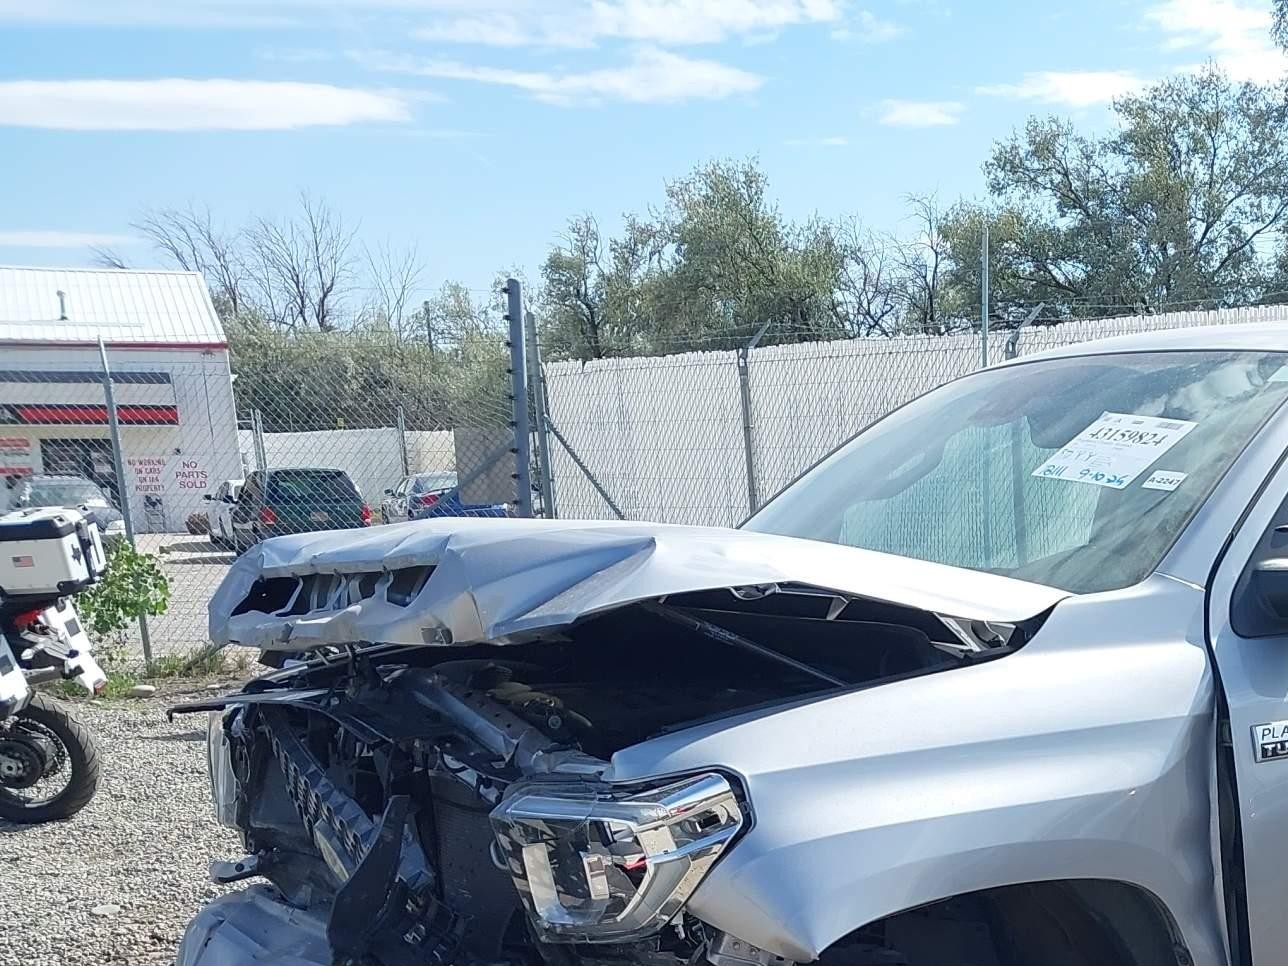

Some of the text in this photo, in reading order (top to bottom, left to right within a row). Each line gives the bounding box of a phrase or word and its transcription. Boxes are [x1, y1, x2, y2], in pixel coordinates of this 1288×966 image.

[1089, 426, 1169, 446] 43159824
[182, 461, 198, 469] NO
[175, 471, 208, 479] PARTS
[179, 480, 207, 489] SOLD
